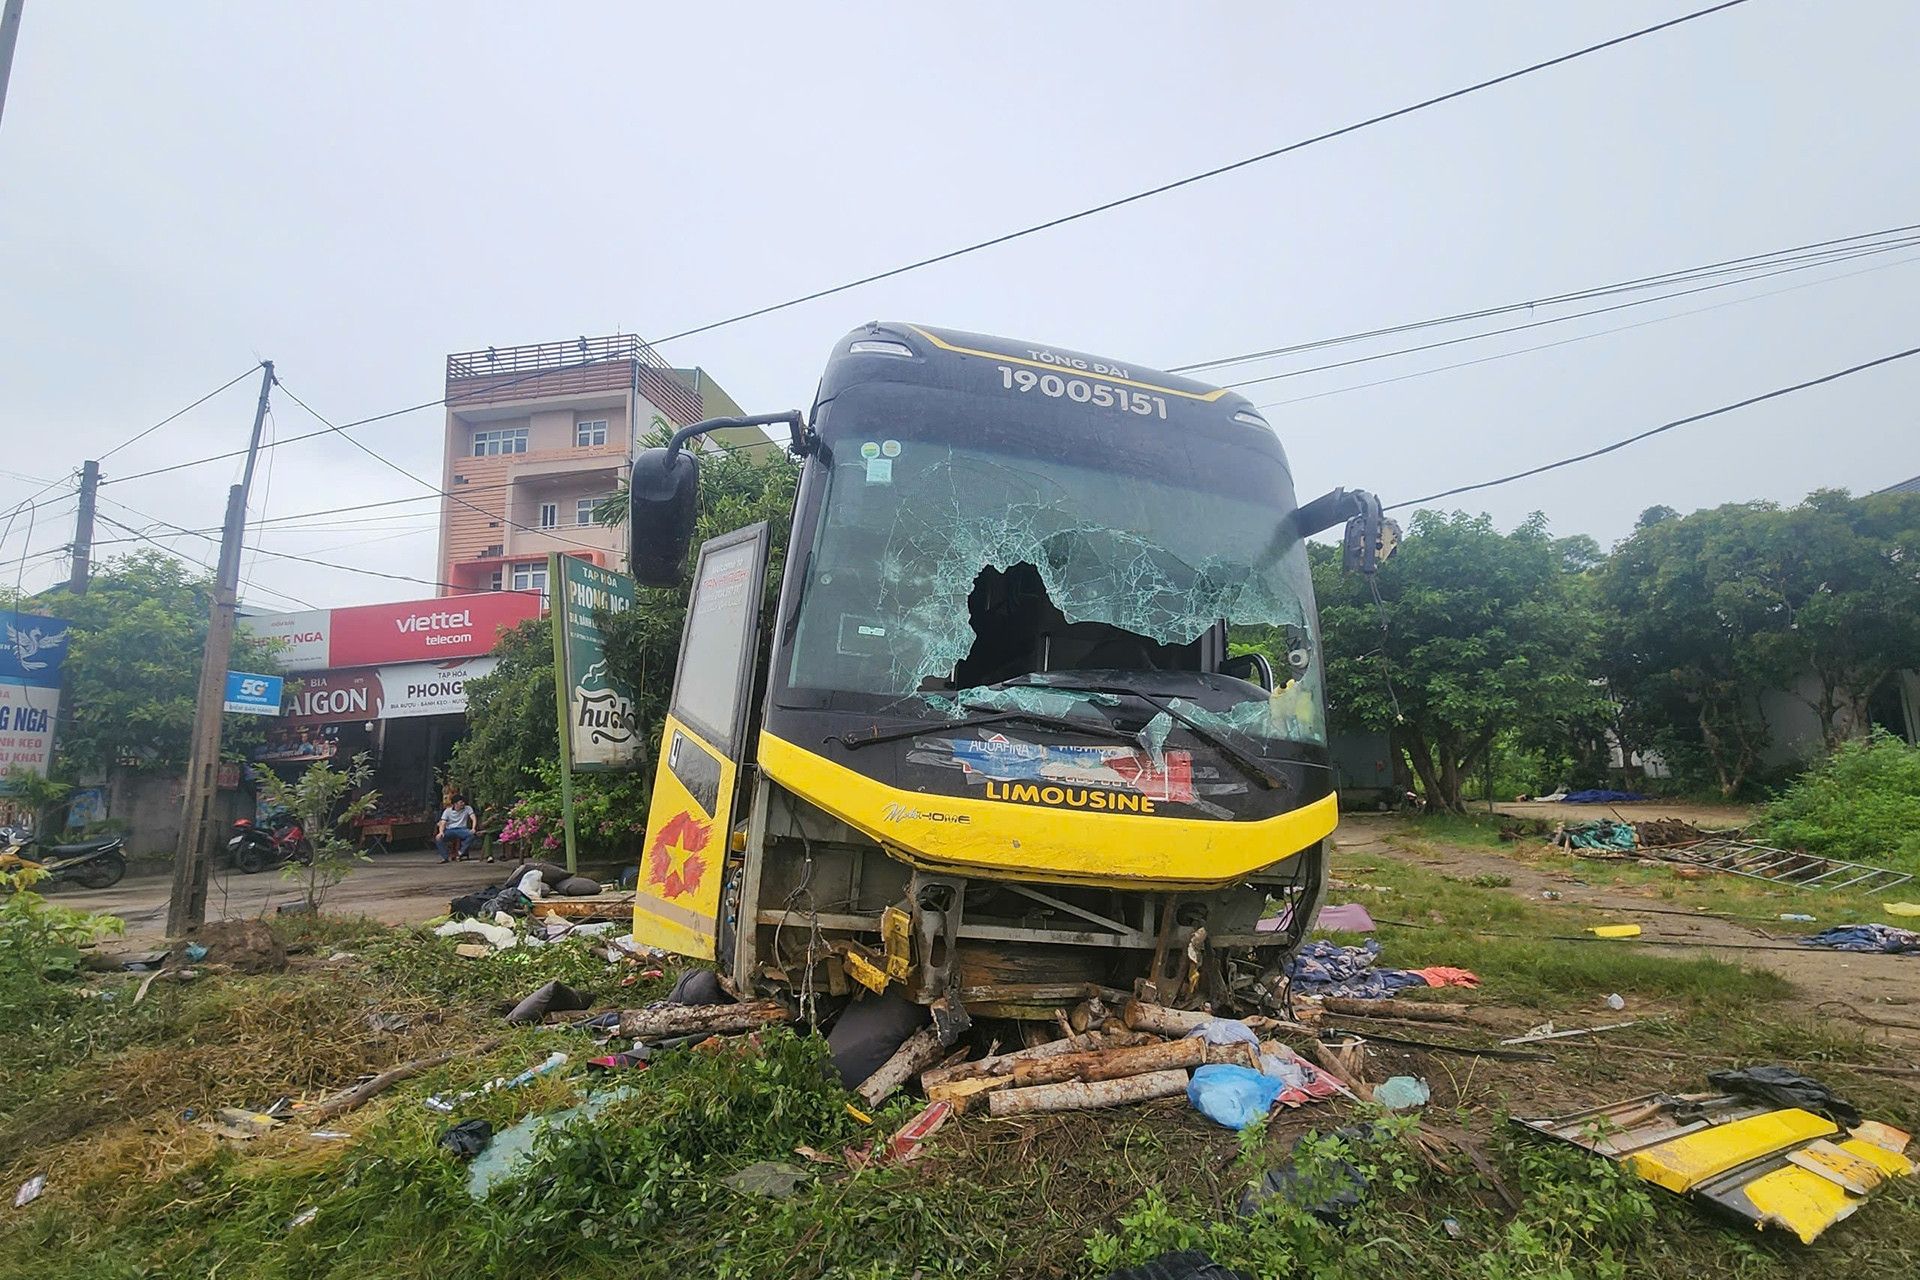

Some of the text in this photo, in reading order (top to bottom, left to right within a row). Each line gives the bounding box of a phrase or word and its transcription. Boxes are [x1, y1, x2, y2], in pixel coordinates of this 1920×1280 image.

[1027, 349, 1130, 380] TỔNG ĐÀI
[998, 366, 1169, 420] 19005151
[582, 566, 618, 588] TẠP HÓA
[569, 580, 608, 611] PHONG
[396, 609, 473, 634] viettel
[293, 631, 323, 644] NGA
[425, 632, 472, 646] telecom
[310, 678, 328, 688] BIA
[438, 671, 451, 680] TẠP
[407, 681, 463, 699] PHONG
[284, 687, 368, 717] AIGON
[14, 707, 48, 733] NGA
[968, 740, 1030, 756] AQUAFINA
[986, 780, 1156, 814] LIMOUSINE
